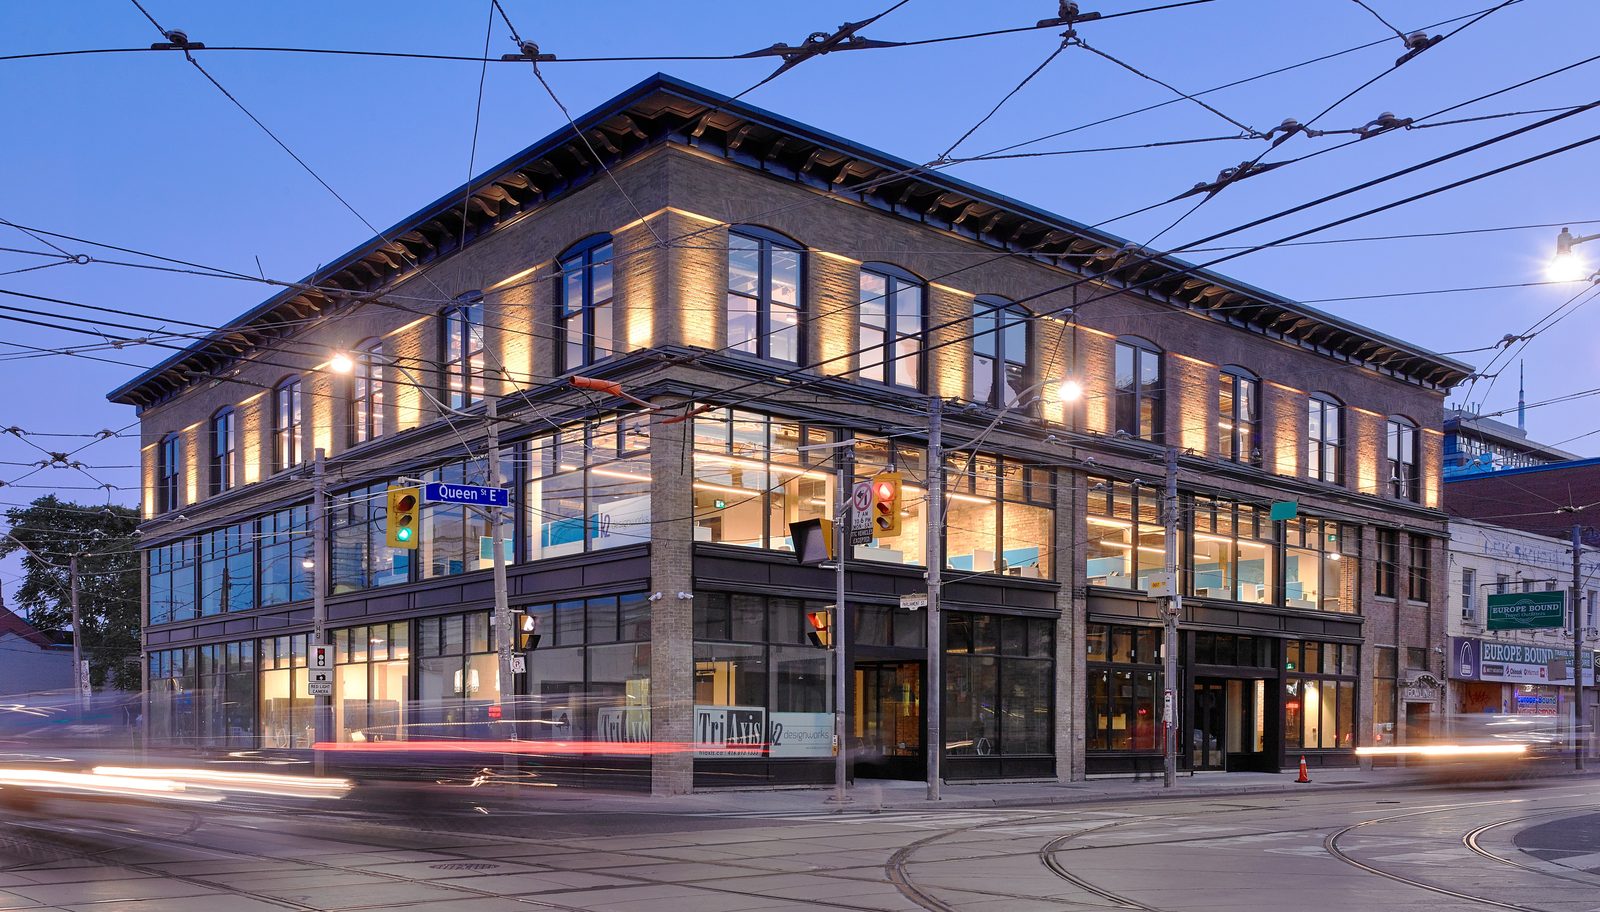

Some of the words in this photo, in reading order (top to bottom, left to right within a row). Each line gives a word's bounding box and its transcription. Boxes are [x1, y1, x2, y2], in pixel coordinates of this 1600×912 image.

[438, 484, 478, 501] Queen
[490, 490, 497, 502] E
[1492, 605, 1527, 614] EUROPE
[1529, 603, 1559, 612] BOUND
[1484, 643, 1522, 662] EUROPE
[1524, 646, 1554, 664] BOUND
[783, 729, 830, 741] designworks
